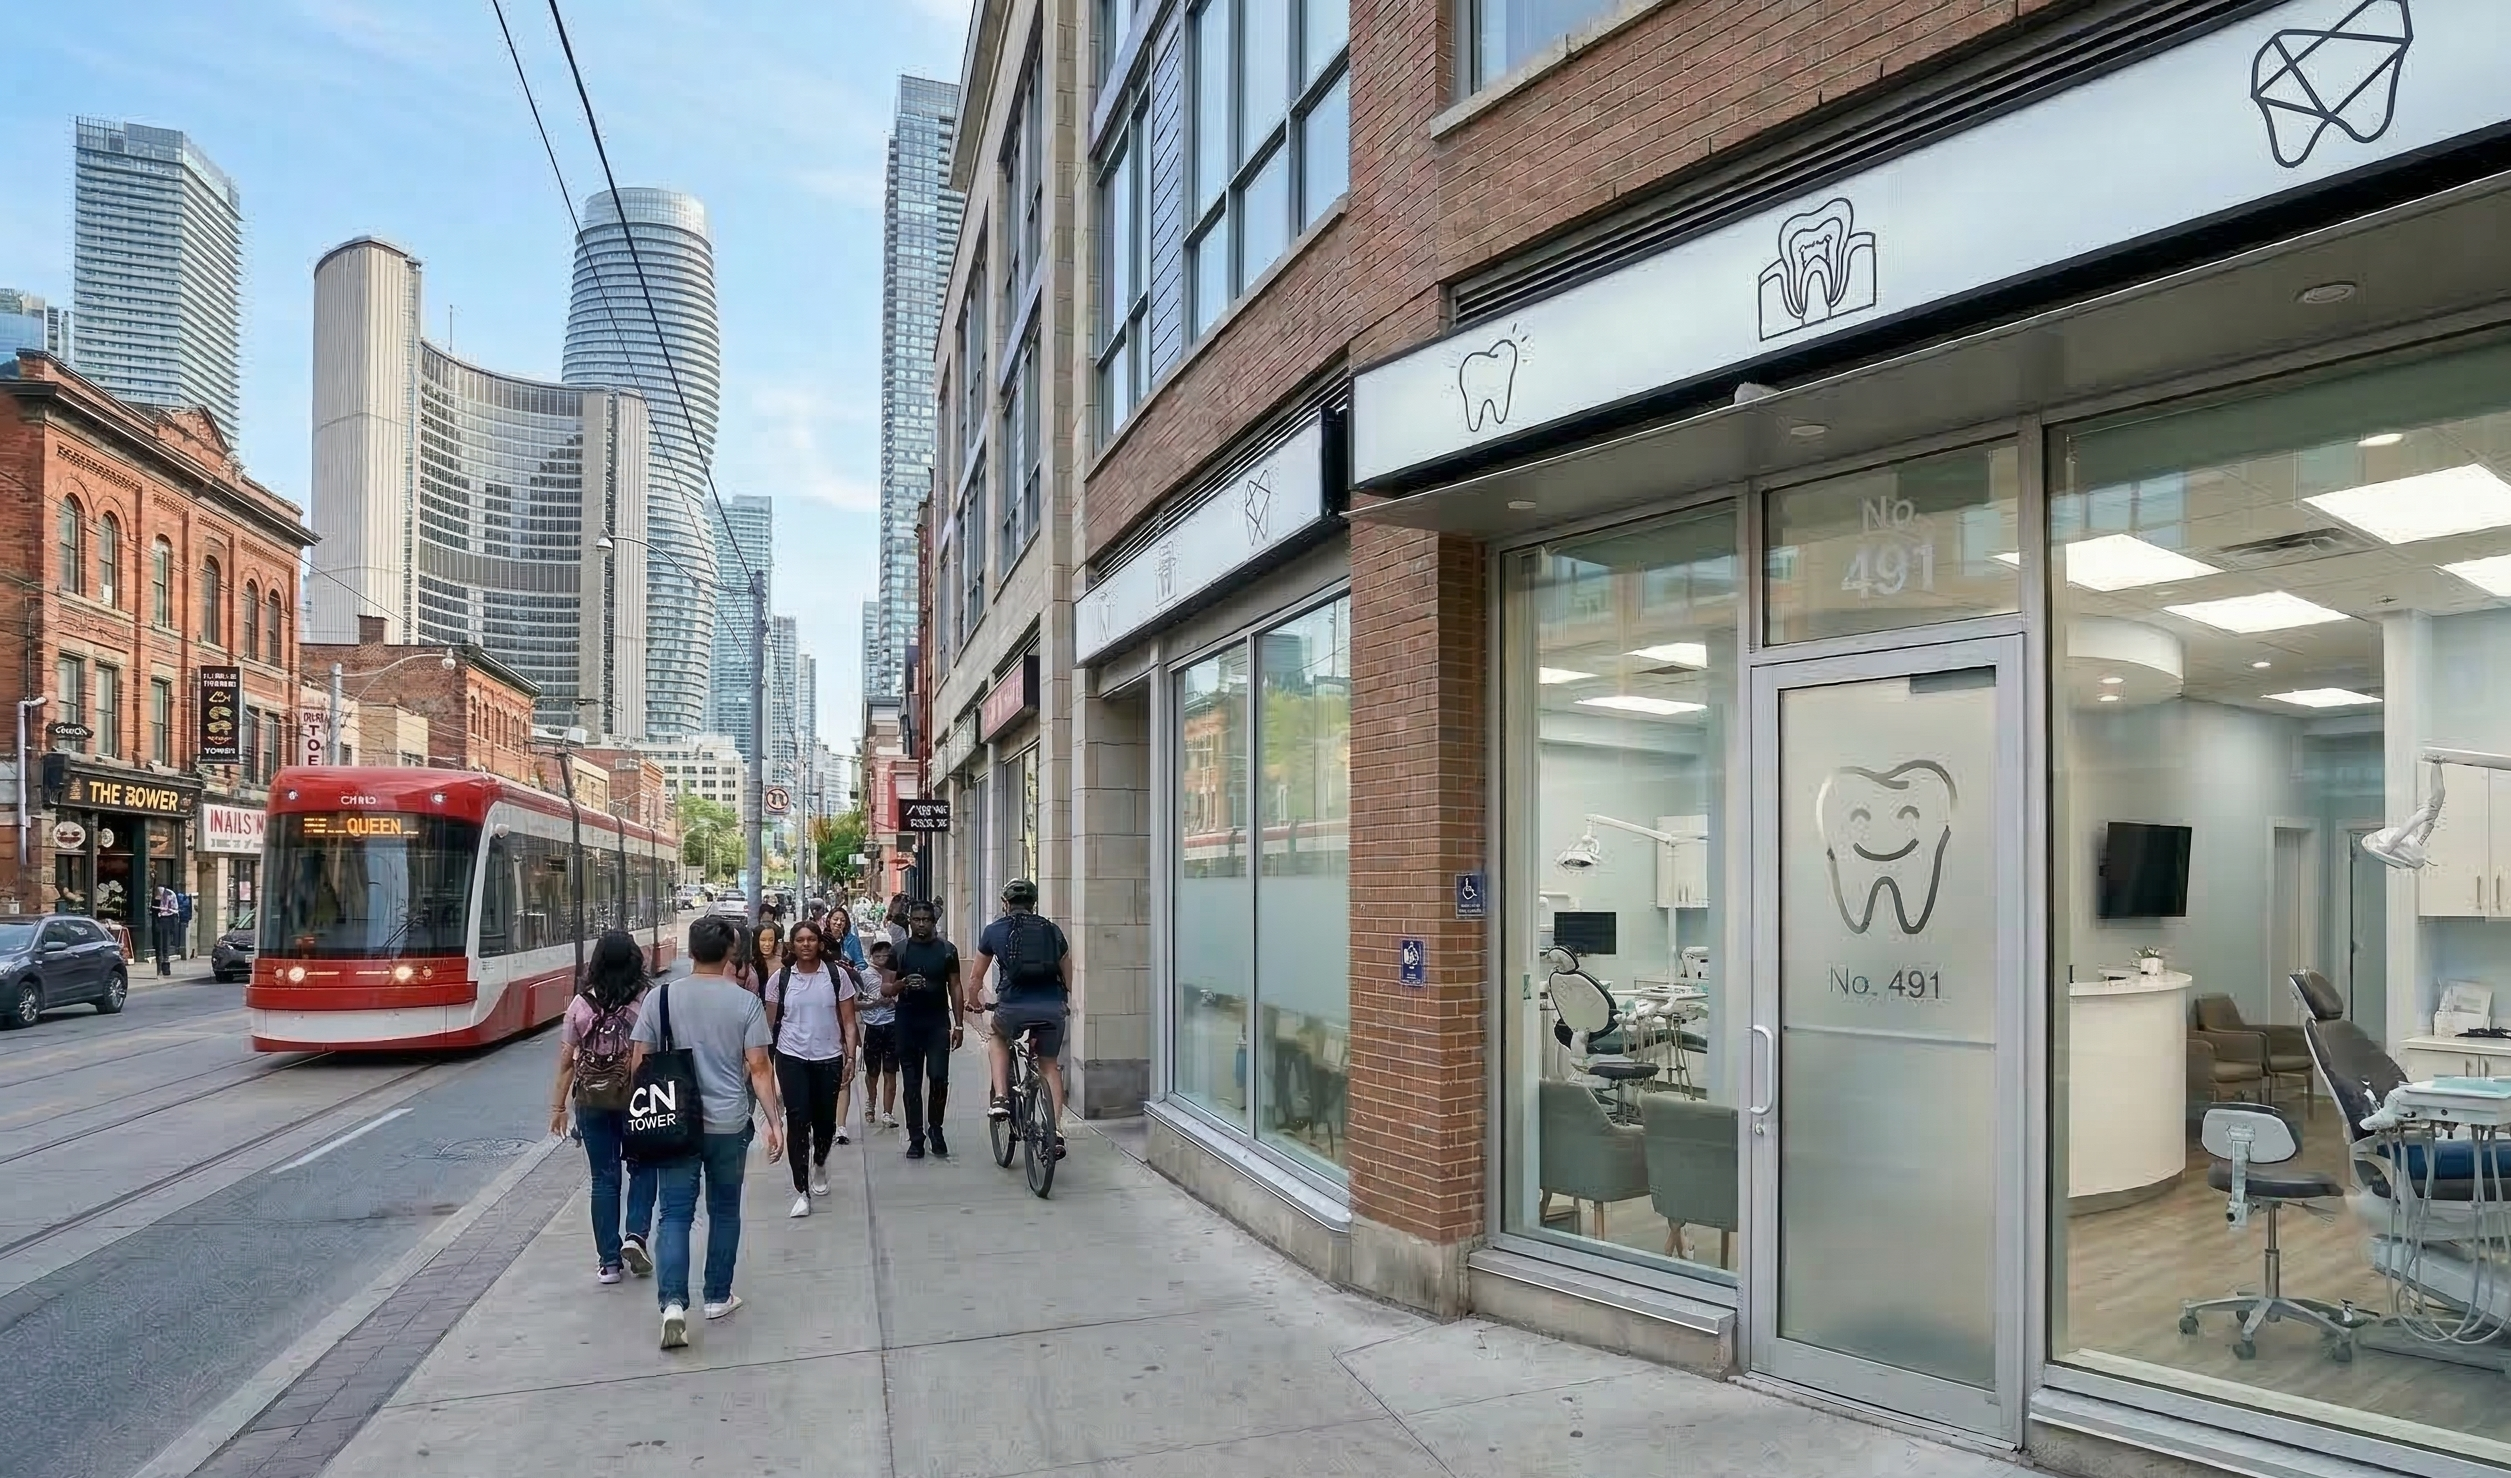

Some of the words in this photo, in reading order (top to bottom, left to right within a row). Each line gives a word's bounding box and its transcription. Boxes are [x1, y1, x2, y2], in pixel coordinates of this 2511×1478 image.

[1841, 545, 1934, 600] 491
[89, 781, 121, 805] THE
[125, 785, 178, 811] BOWER
[347, 817, 402, 837] QUEEN
[1888, 969, 1939, 999] 491
[629, 1080, 676, 1118] CN
[628, 1112, 676, 1132] TOWER
